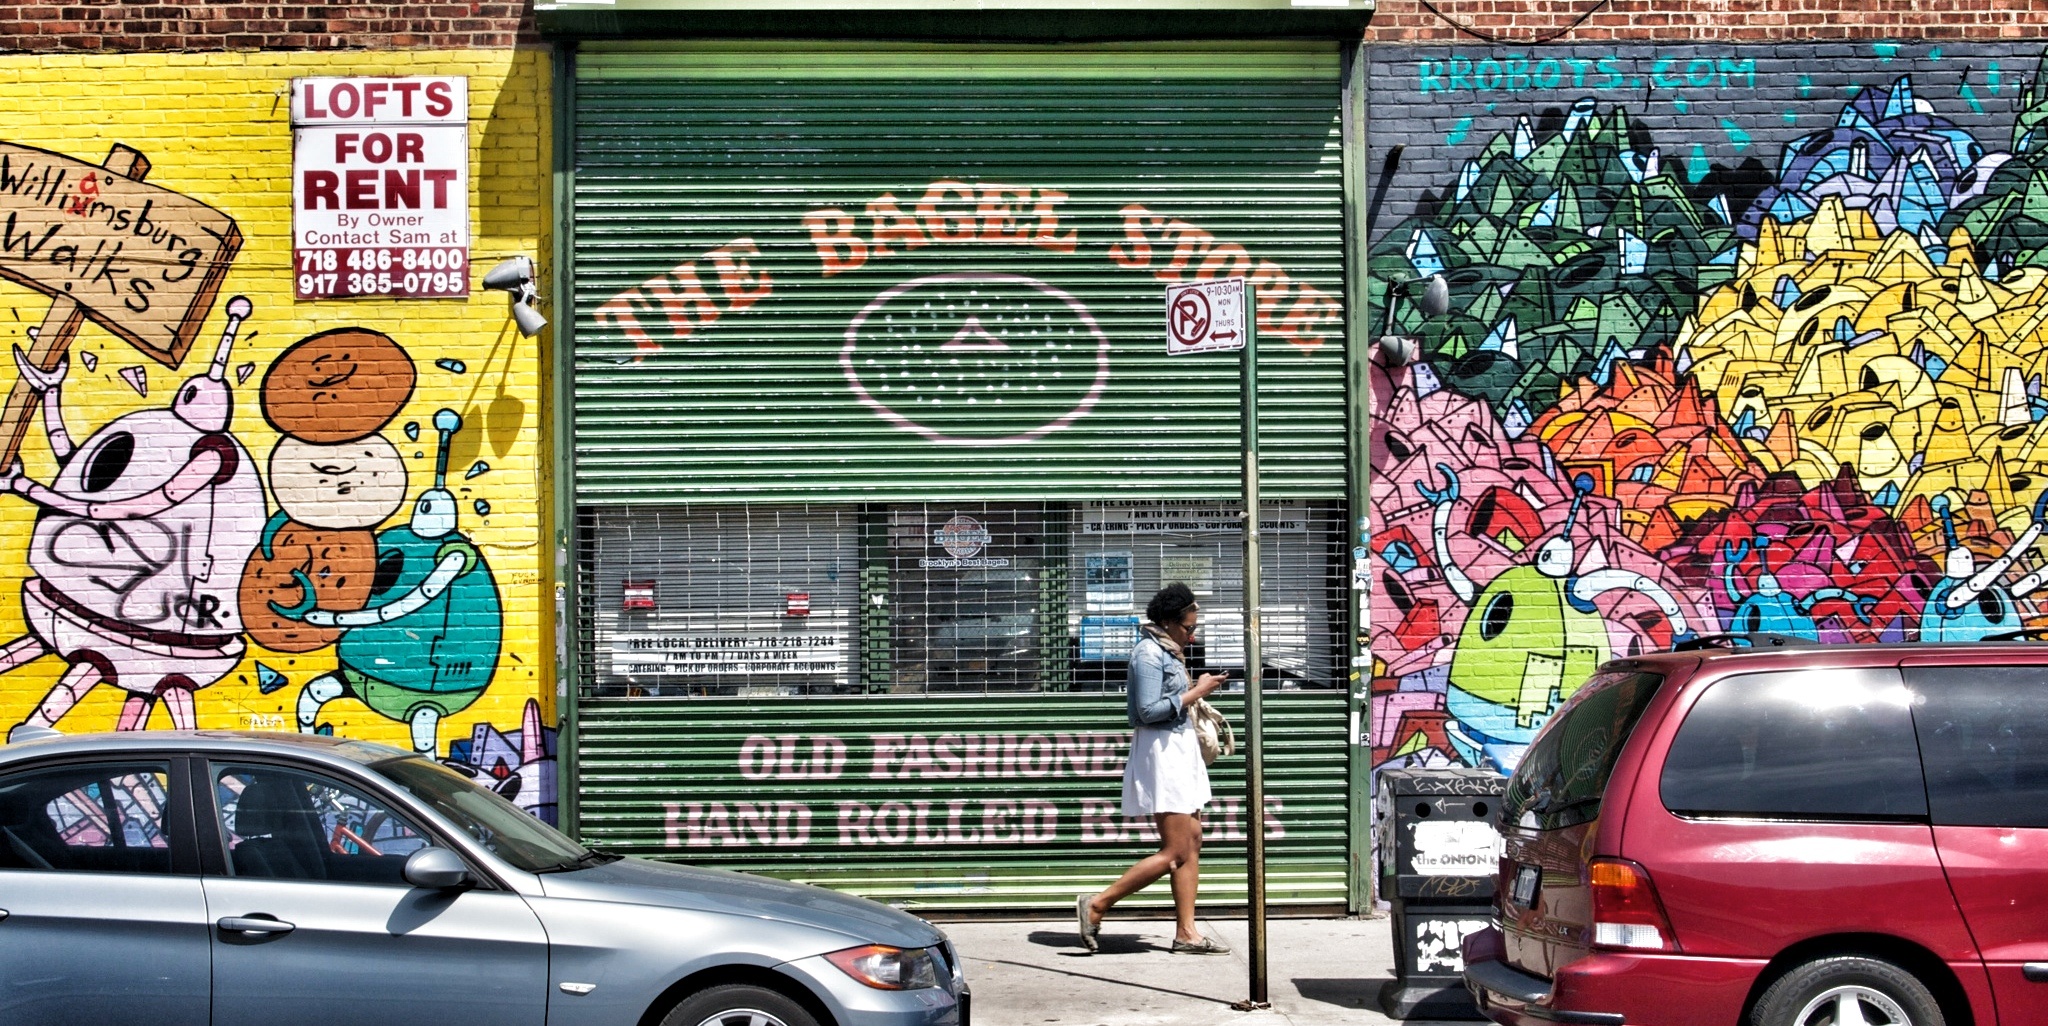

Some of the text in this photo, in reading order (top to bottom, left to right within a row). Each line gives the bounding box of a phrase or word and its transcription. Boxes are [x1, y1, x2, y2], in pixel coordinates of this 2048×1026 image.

[1419, 53, 1756, 94] RROBOTS.COM
[304, 81, 453, 119] LOFTS
[335, 132, 424, 164] FOR
[303, 169, 457, 210] RENT
[337, 213, 424, 229] By Owner
[305, 229, 458, 245] Contact Sam at
[2, 211, 156, 314] Walks
[299, 248, 463, 271] 718 486-8400
[299, 272, 463, 294] 917 365-0795
[593, 238, 774, 364] THE
[803, 180, 1078, 278] BAGEL
[1215, 319, 1235, 327] THURS
[1091, 522, 1129, 531] CAERING
[962, 559, 982, 567] Best
[983, 559, 1009, 568] Bagels
[737, 732, 1133, 779] OLD FASHIONE
[661, 801, 813, 847] HAND
[834, 798, 1059, 846] ROLLED
[1416, 854, 1438, 865] the
[1439, 853, 1487, 865] ONION
[1558, 926, 1569, 936] LX
